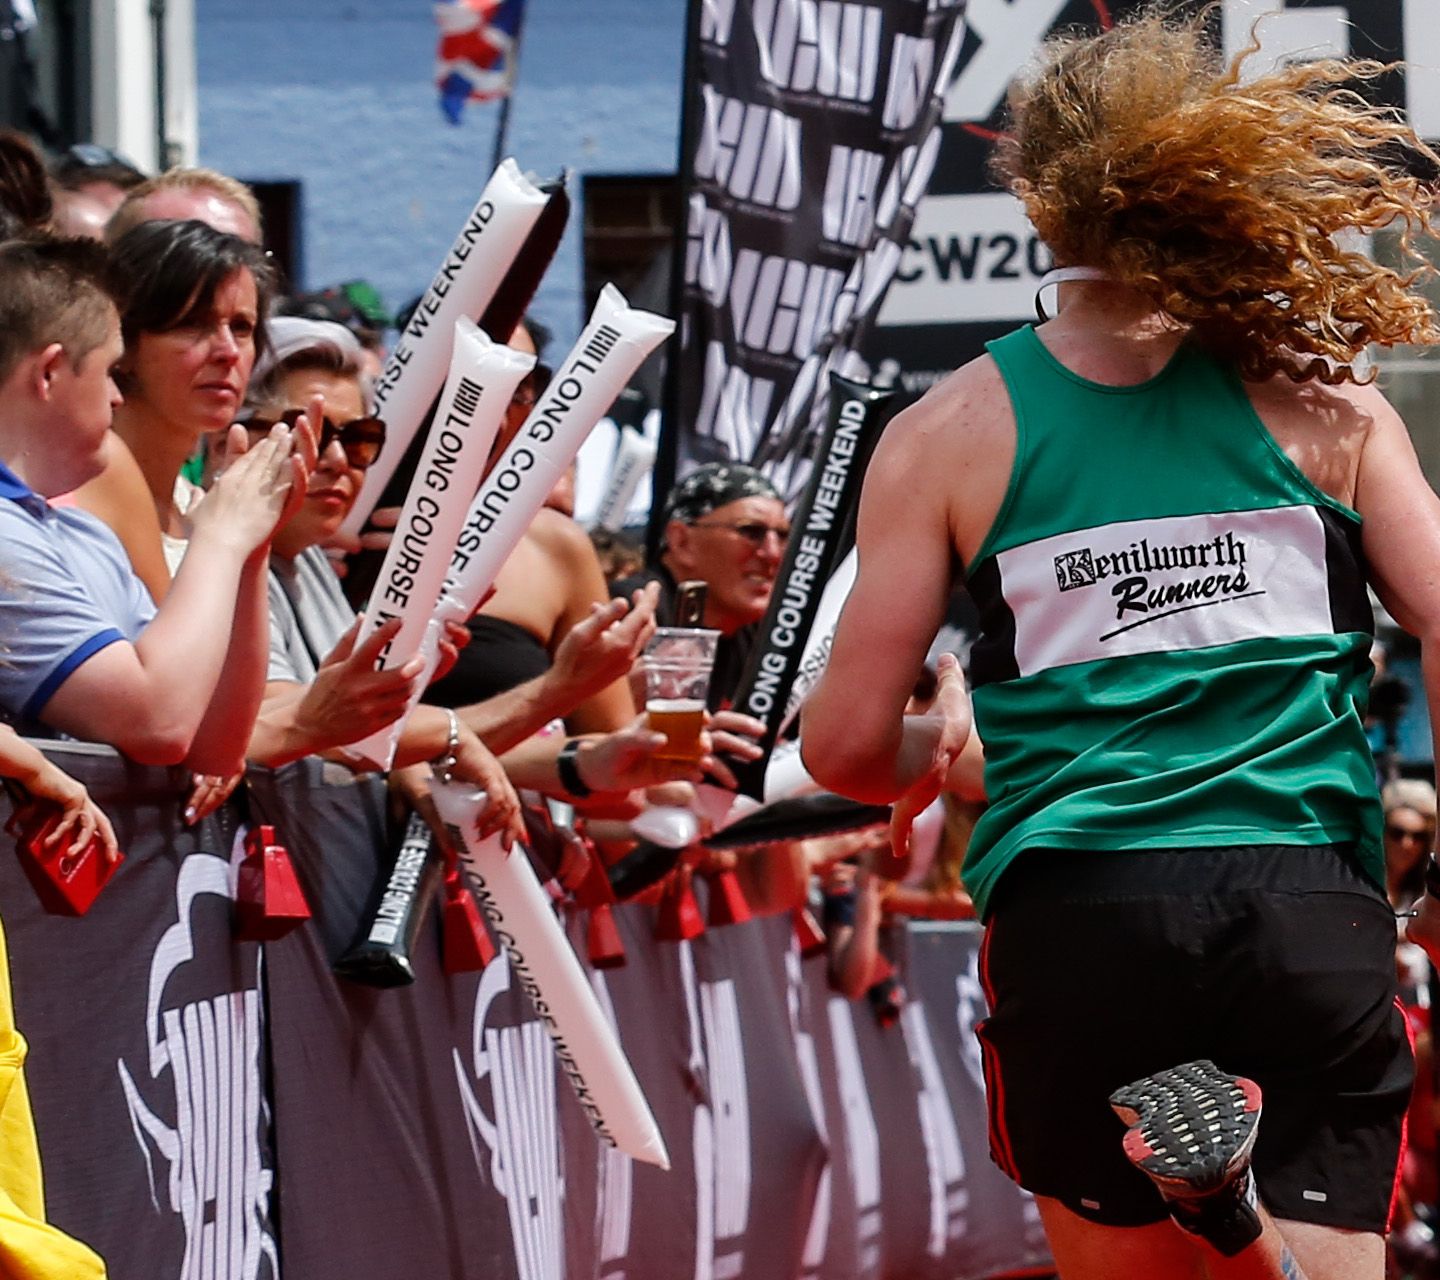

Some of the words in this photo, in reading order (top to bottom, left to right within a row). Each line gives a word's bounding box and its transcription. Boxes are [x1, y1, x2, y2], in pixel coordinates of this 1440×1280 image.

[409, 200, 496, 339] WEEKEND
[424, 412, 471, 493] LONG
[528, 359, 598, 443] LONG
[384, 495, 441, 610] COURSE
[448, 448, 535, 572] COURSE
[769, 532, 826, 650] COURSE
[807, 398, 867, 532] WEEKEND
[1053, 531, 1247, 592] Kenilworth
[1111, 568, 1251, 620] Runners
[551, 1033, 619, 1150] WEEKEND
